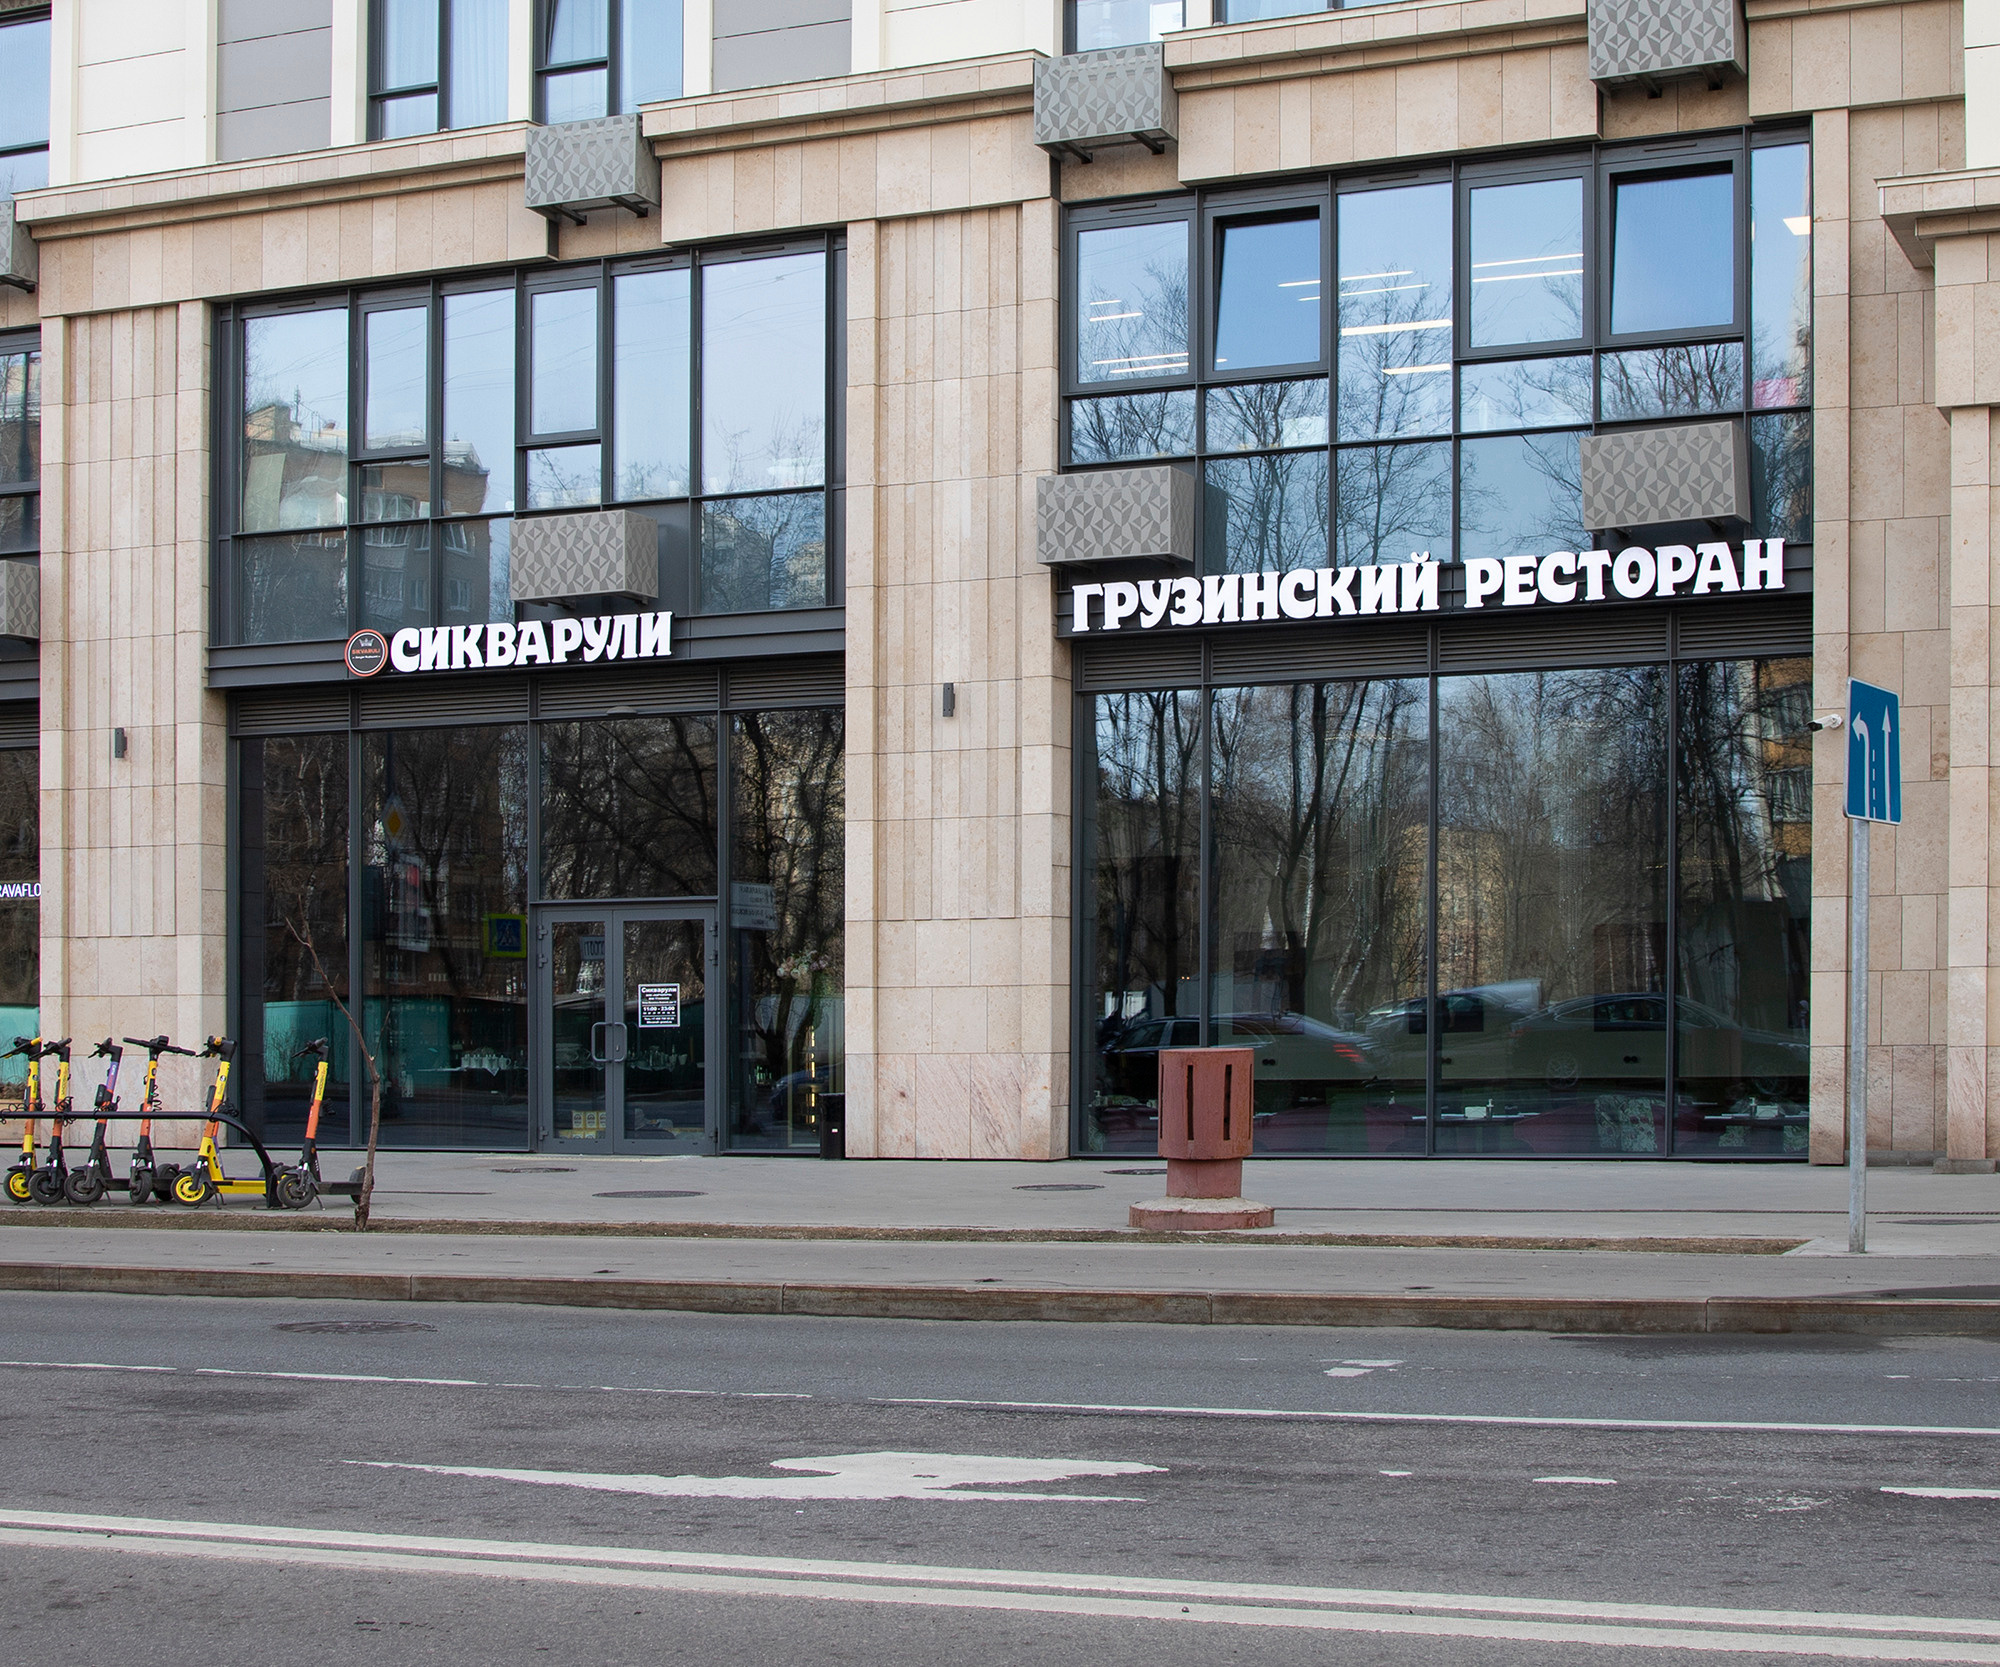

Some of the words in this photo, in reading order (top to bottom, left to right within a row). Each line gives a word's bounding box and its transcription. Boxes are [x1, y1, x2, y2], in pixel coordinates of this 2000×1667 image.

[1072, 551, 1440, 632] ГРУЗИНСКИЙ
[1463, 537, 1786, 608] РЕСТОРАН
[390, 611, 673, 673] СИКВАРУЛИ
